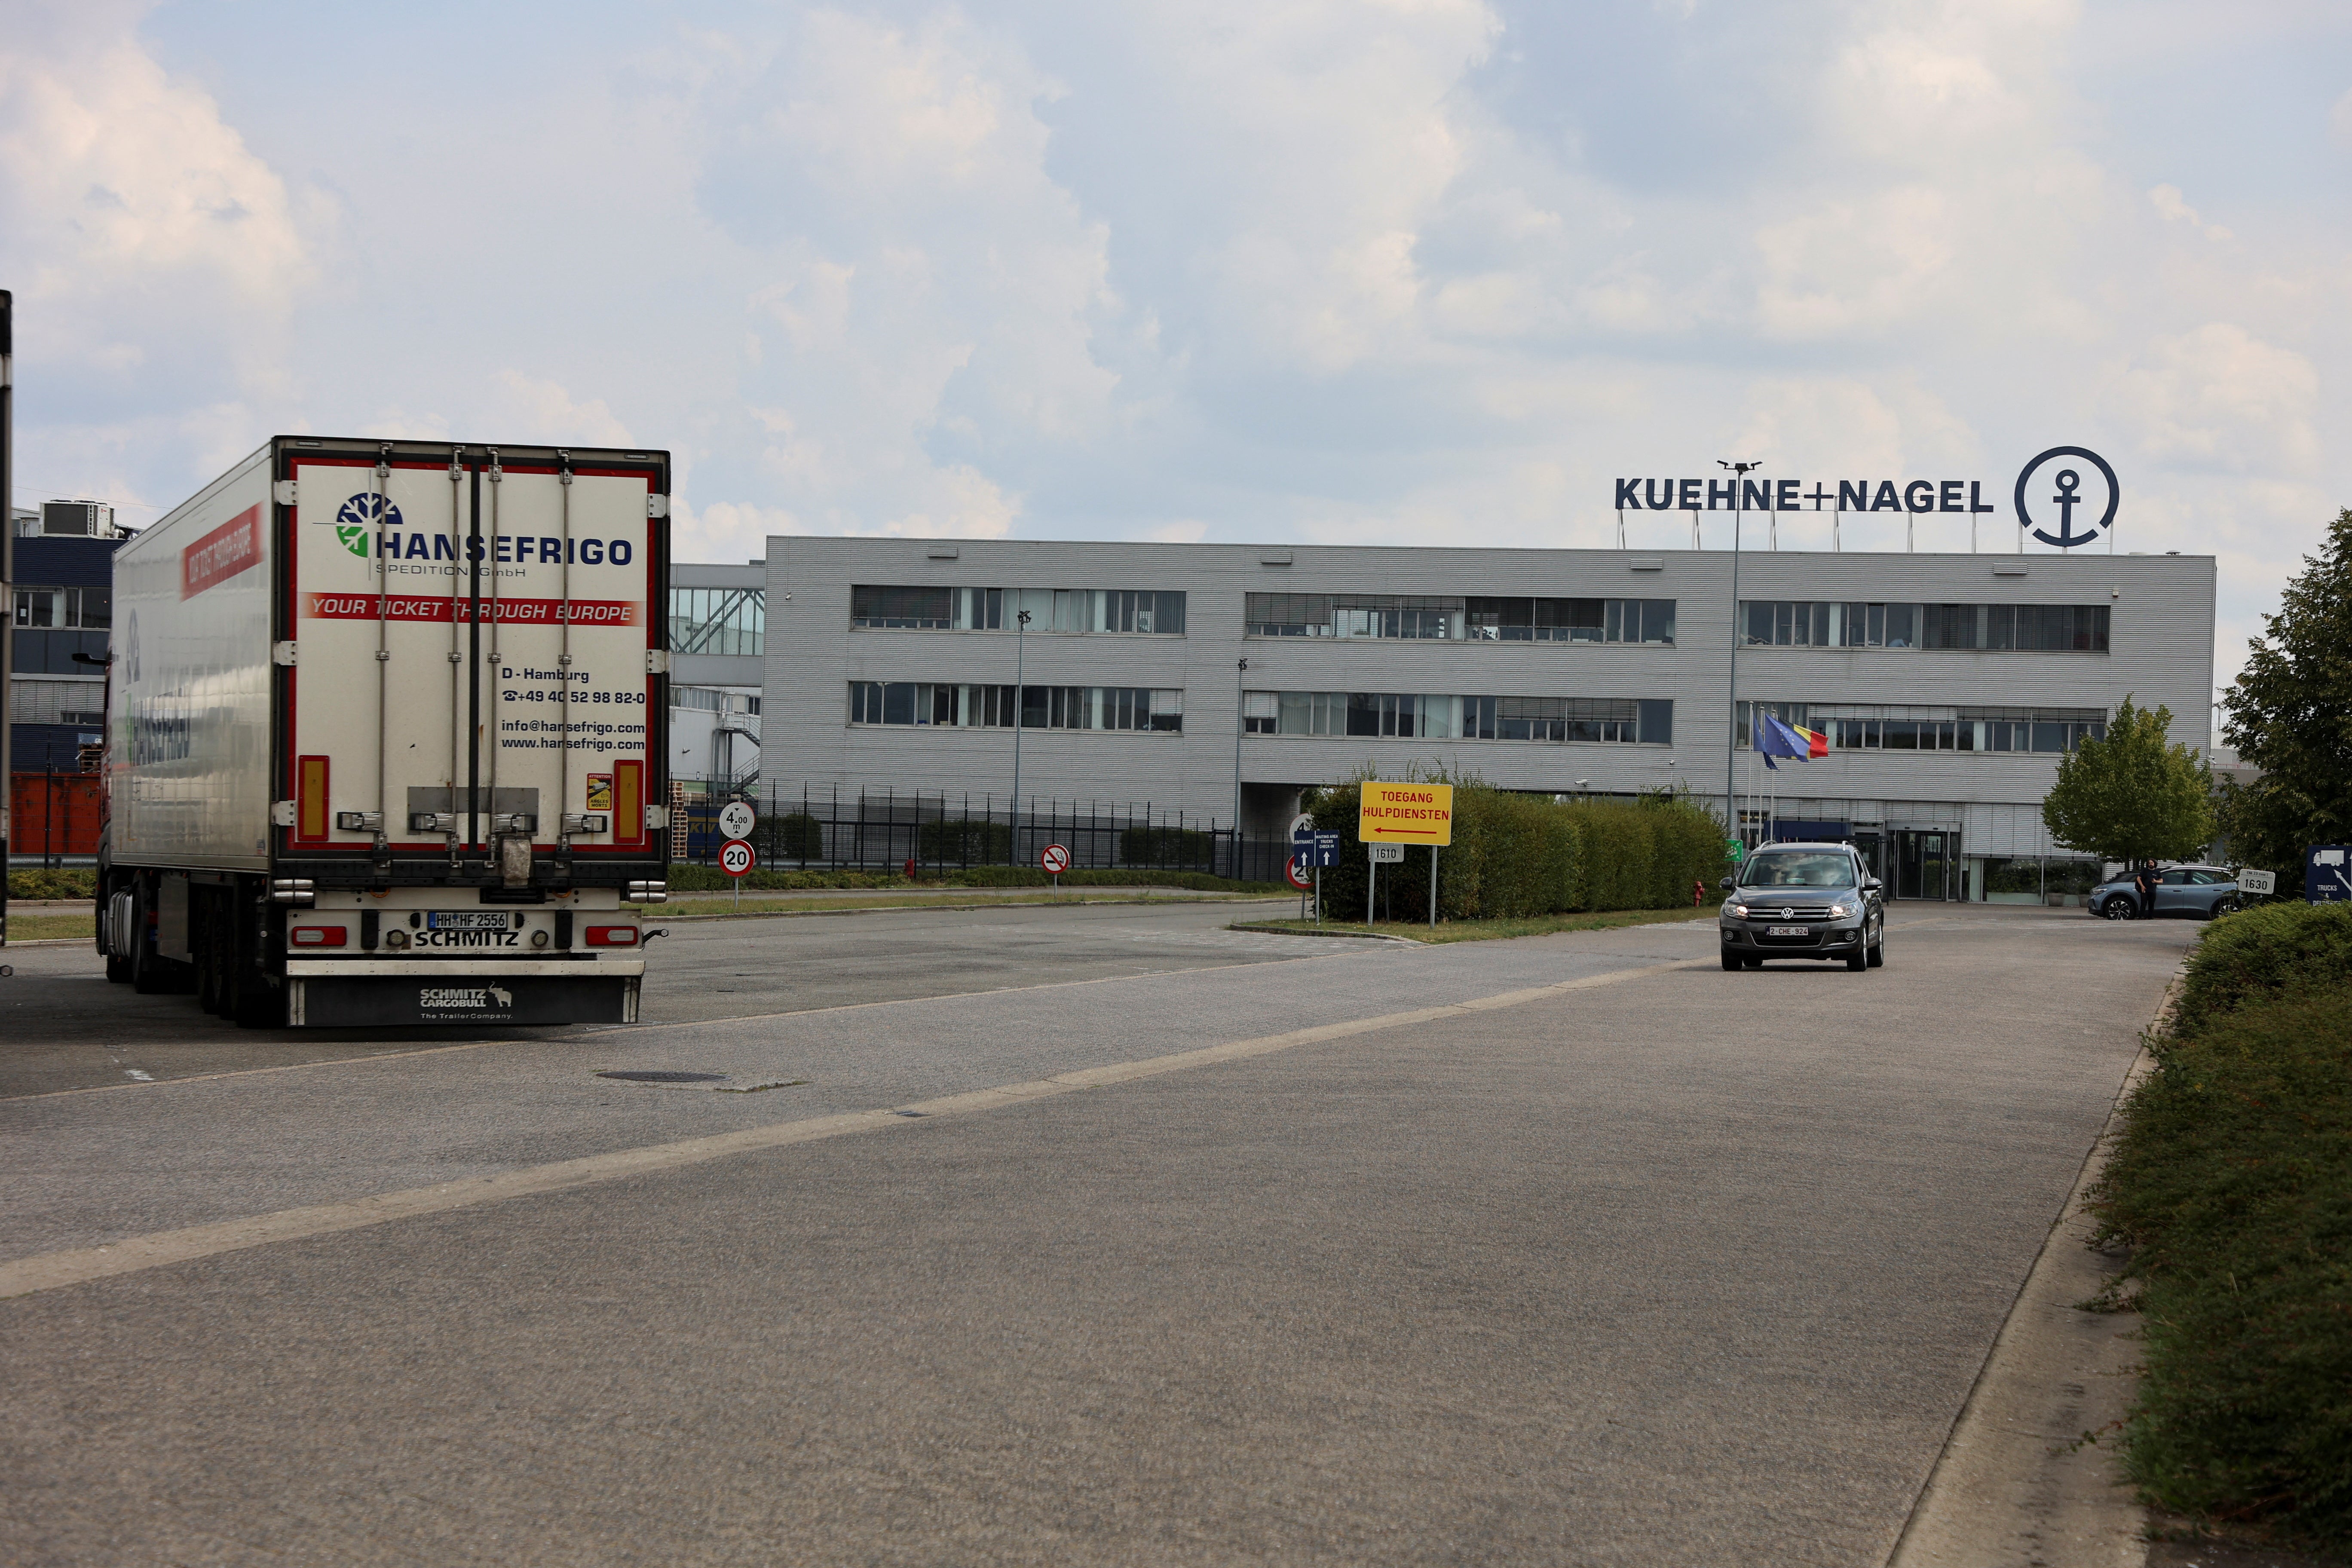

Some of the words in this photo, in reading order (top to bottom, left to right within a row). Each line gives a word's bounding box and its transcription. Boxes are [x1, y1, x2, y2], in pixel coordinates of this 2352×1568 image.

[1615, 478, 1994, 513] KUEHNE+NAGEL
[376, 532, 631, 565] HANSEFRIGO
[376, 564, 468, 576] SPEDITION
[479, 567, 526, 577] GmbH
[312, 599, 367, 614] YOUR
[375, 600, 444, 616] TICKET
[450, 603, 547, 618] THROUGH
[555, 605, 633, 621] EUROPE
[502, 668, 512, 679] D
[524, 668, 589, 683] Hamburg
[548, 691, 564, 702] 40
[570, 692, 588, 703] 52
[593, 692, 610, 703] 98
[615, 692, 645, 704] 82-0
[502, 720, 645, 735] info@hansefrigo.com
[502, 737, 645, 752] www.hansefrigo.com
[1381, 791, 1433, 803] TOEGANG
[726, 812, 747, 824] 4.00
[1363, 807, 1449, 820] HULPDIENSTEN
[726, 851, 747, 866] 20
[1376, 848, 1396, 858] 1610
[2245, 879, 2268, 890] 1630
[436, 914, 451, 926] HH
[460, 914, 474, 926] HF
[477, 914, 505, 926] 2556
[415, 932, 519, 946] SCHMITZ
[420, 989, 487, 999] SCHMITZ
